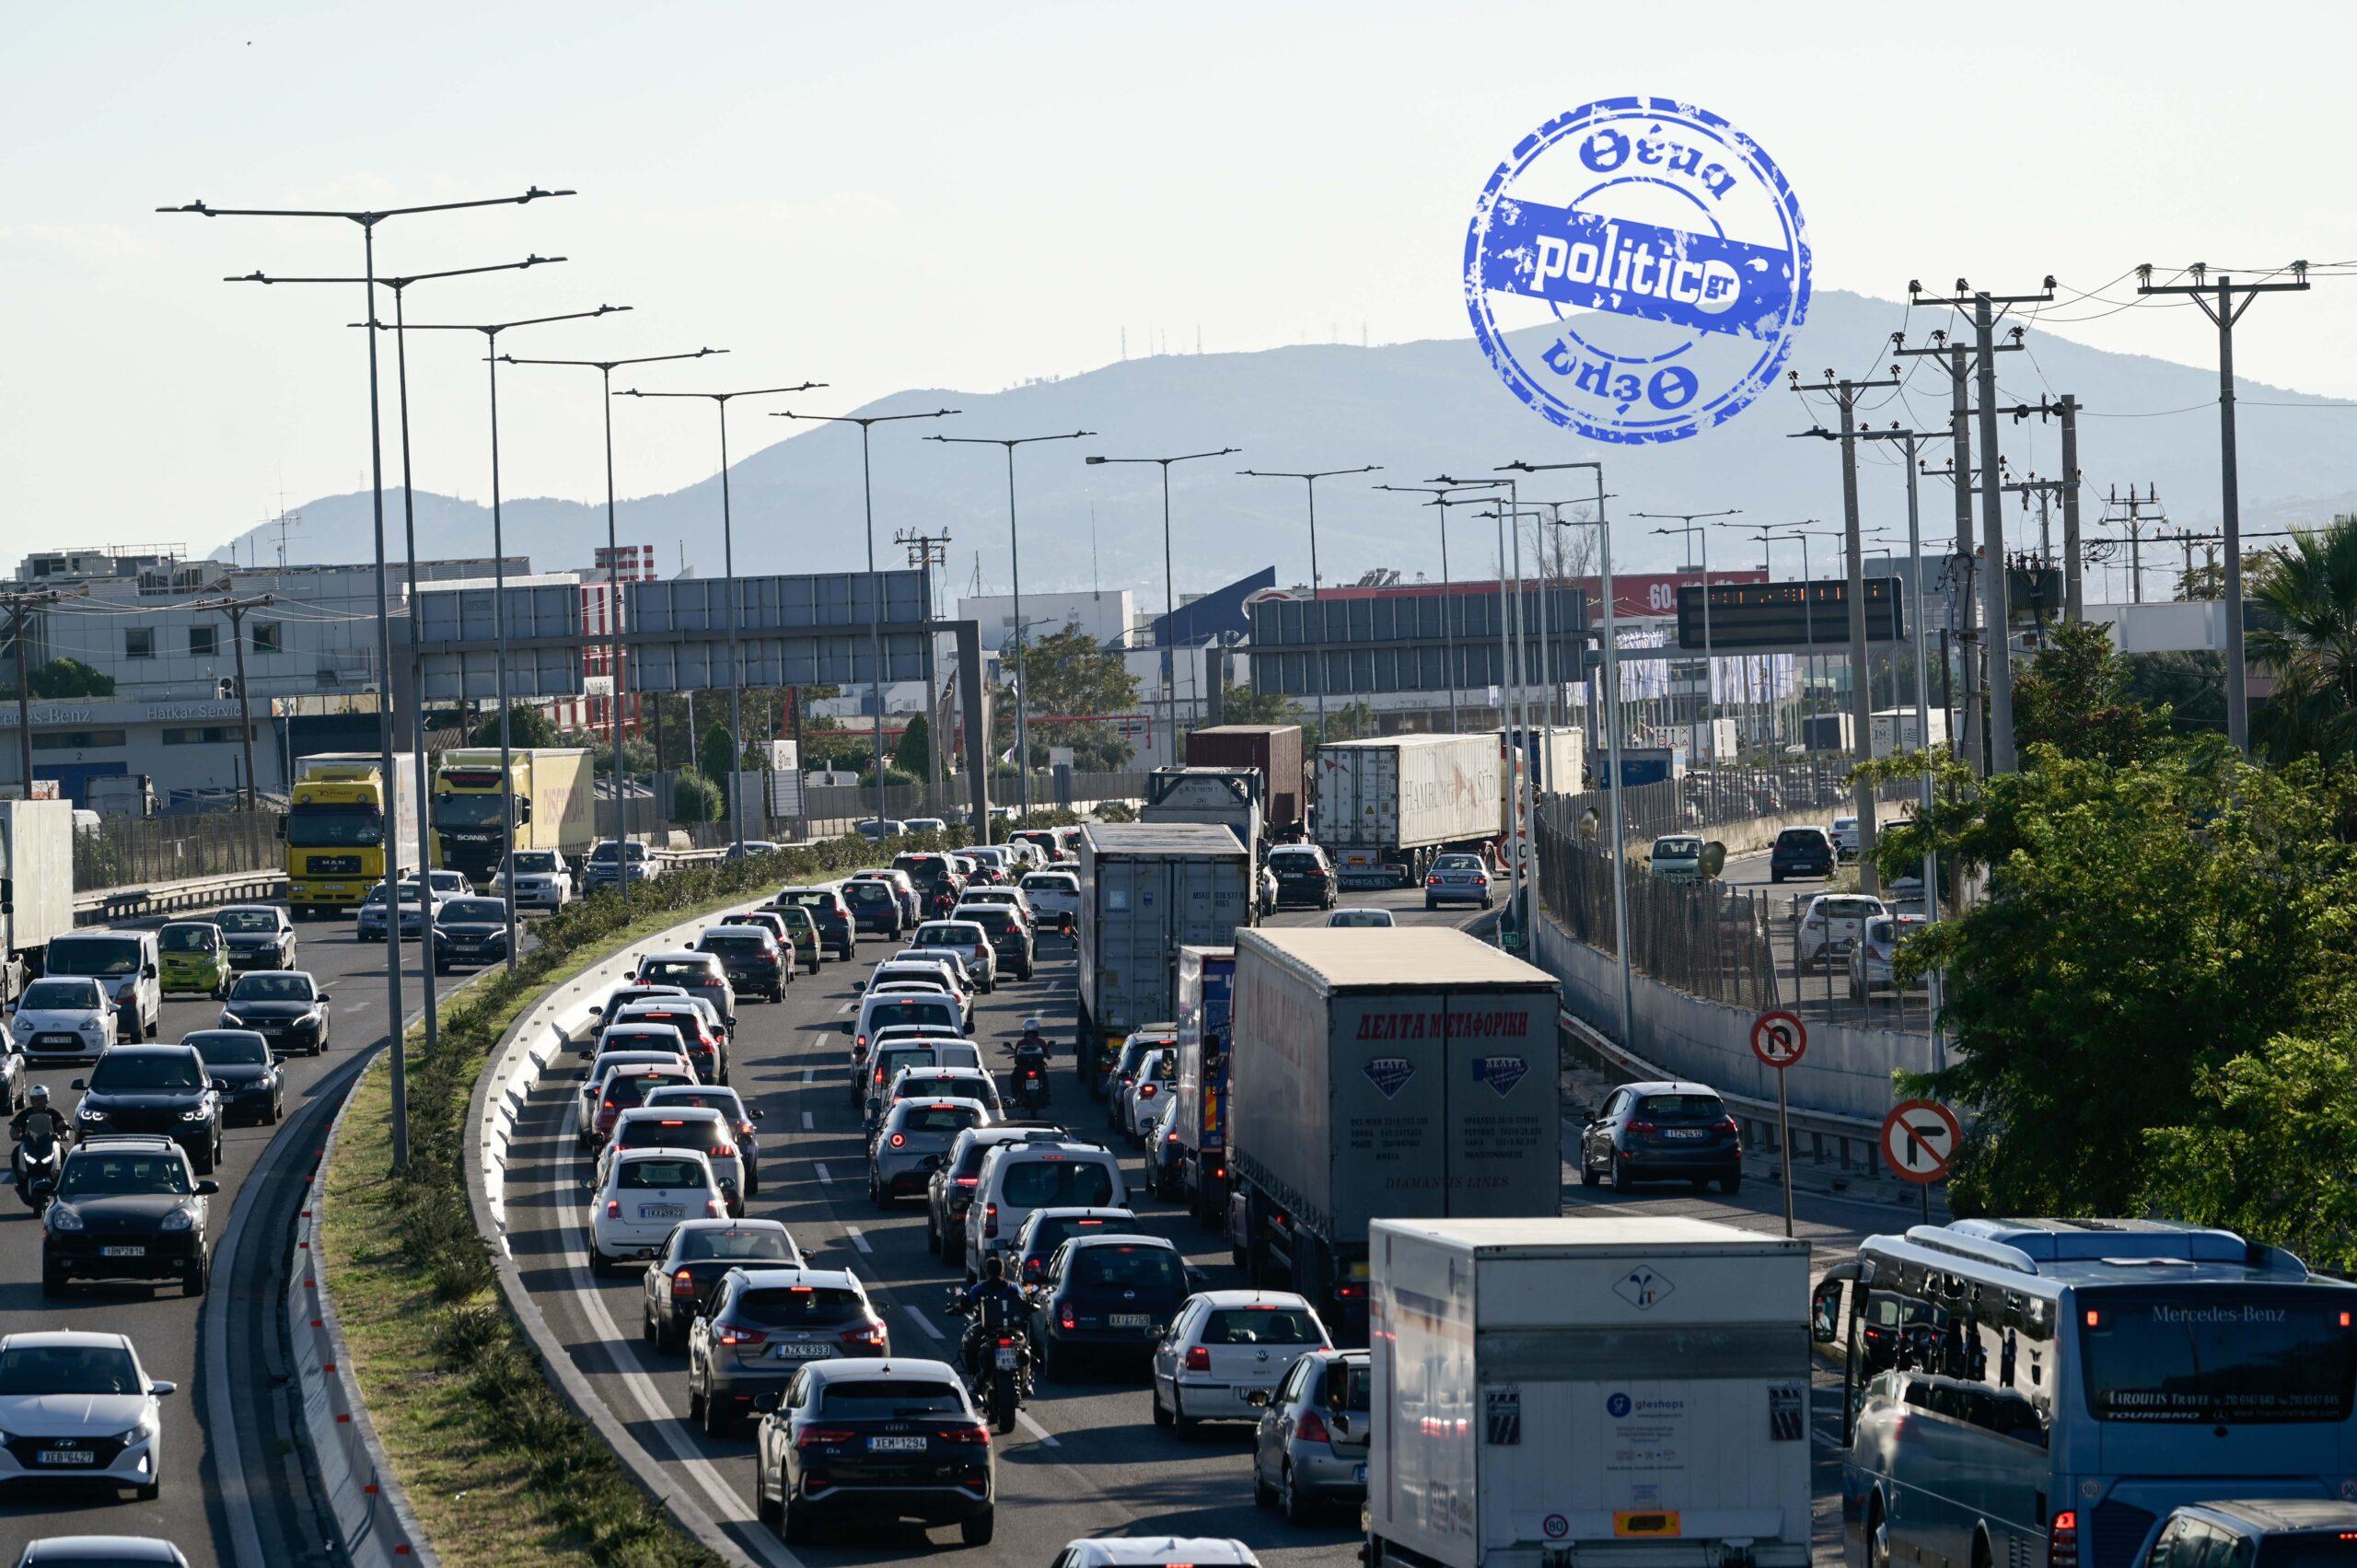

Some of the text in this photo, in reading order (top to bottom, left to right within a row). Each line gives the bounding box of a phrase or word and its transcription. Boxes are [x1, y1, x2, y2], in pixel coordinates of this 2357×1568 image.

[1405, 780, 1455, 811] HAMBURG
[1356, 1013, 1424, 1040] ΔΕΛΤΑ
[2153, 1305, 2285, 1322] Mercedes-Benz
[2107, 1411, 2200, 1420] TOURISMO
[1548, 1521, 1563, 1532] 80
